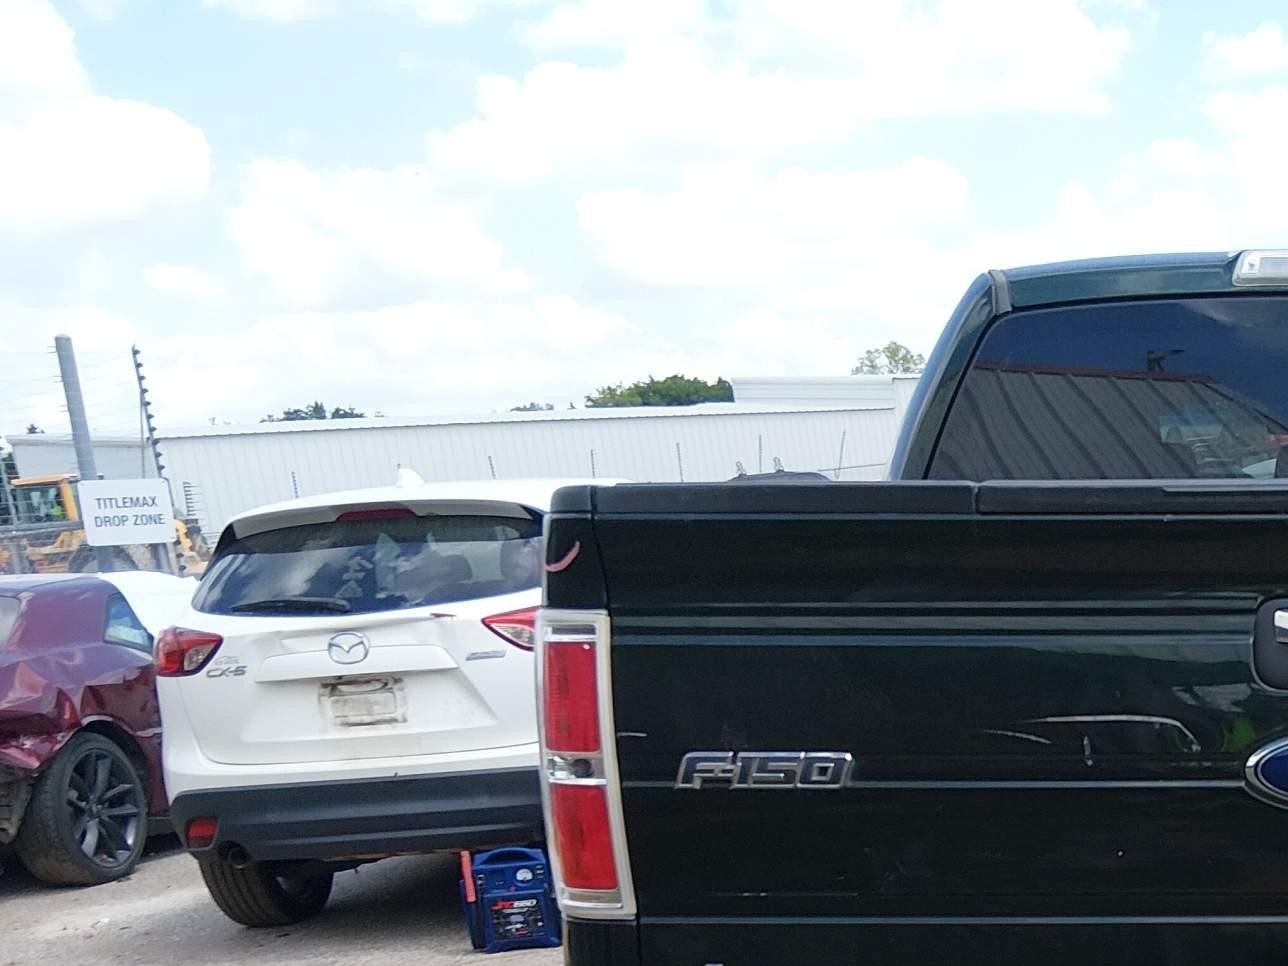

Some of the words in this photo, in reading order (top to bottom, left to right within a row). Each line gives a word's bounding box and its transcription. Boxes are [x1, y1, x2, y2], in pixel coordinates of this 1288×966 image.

[94, 496, 158, 509] TITLEMAX
[94, 514, 129, 528] DROP
[132, 513, 166, 526] ZONE
[206, 665, 248, 678] CX-5
[673, 751, 855, 790] F-150
